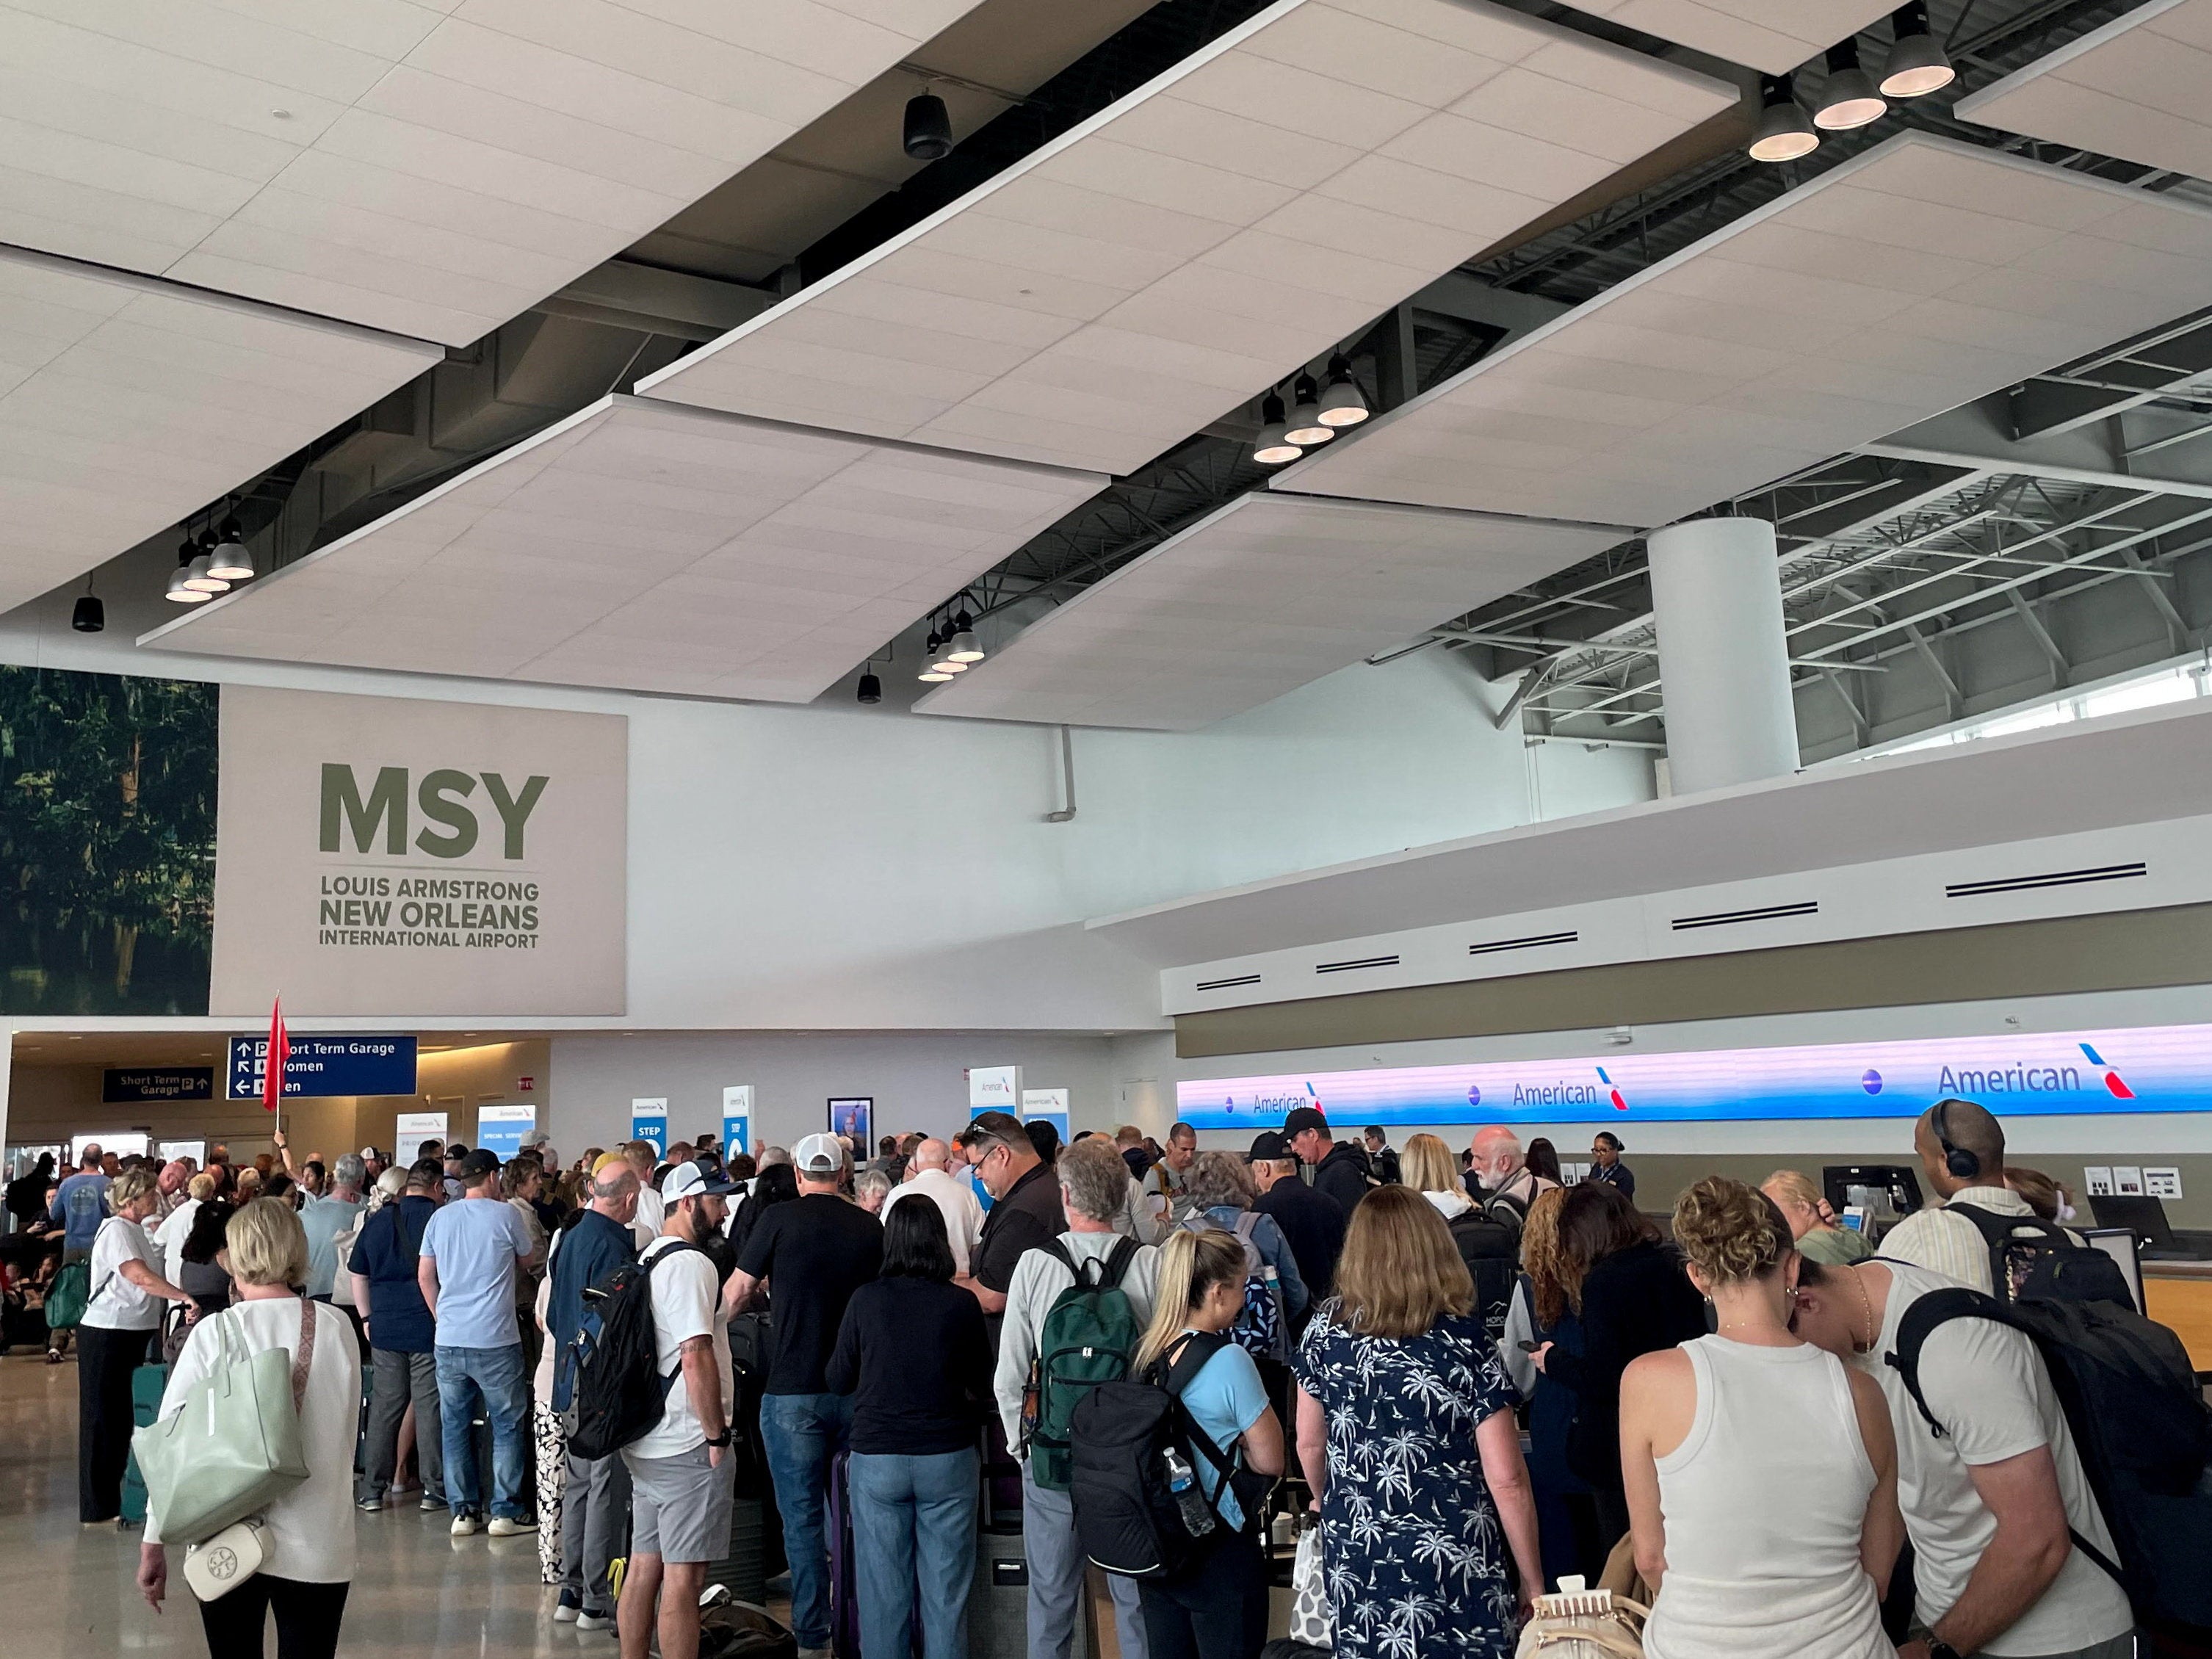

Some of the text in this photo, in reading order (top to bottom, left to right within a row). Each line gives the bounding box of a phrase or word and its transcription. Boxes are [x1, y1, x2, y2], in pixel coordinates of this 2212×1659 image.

[319, 763, 550, 860] MSY
[321, 875, 539, 901] LOUIS ARMSTRONG
[319, 899, 539, 931] NEW ORLEANS
[319, 929, 538, 949] INTERNATIONAL AIRPORT
[291, 1044, 309, 1055] ort
[313, 1043, 345, 1055] Term
[349, 1043, 395, 1057] Garage
[120, 1076, 150, 1085] Short
[154, 1076, 180, 1085] Term
[285, 1082, 301, 1092] en
[1938, 1062, 2081, 1094] American
[141, 1085, 179, 1096] Garage
[1513, 1080, 1597, 1106] American
[1254, 1094, 1306, 1113] American
[638, 1127, 661, 1136] STEP
